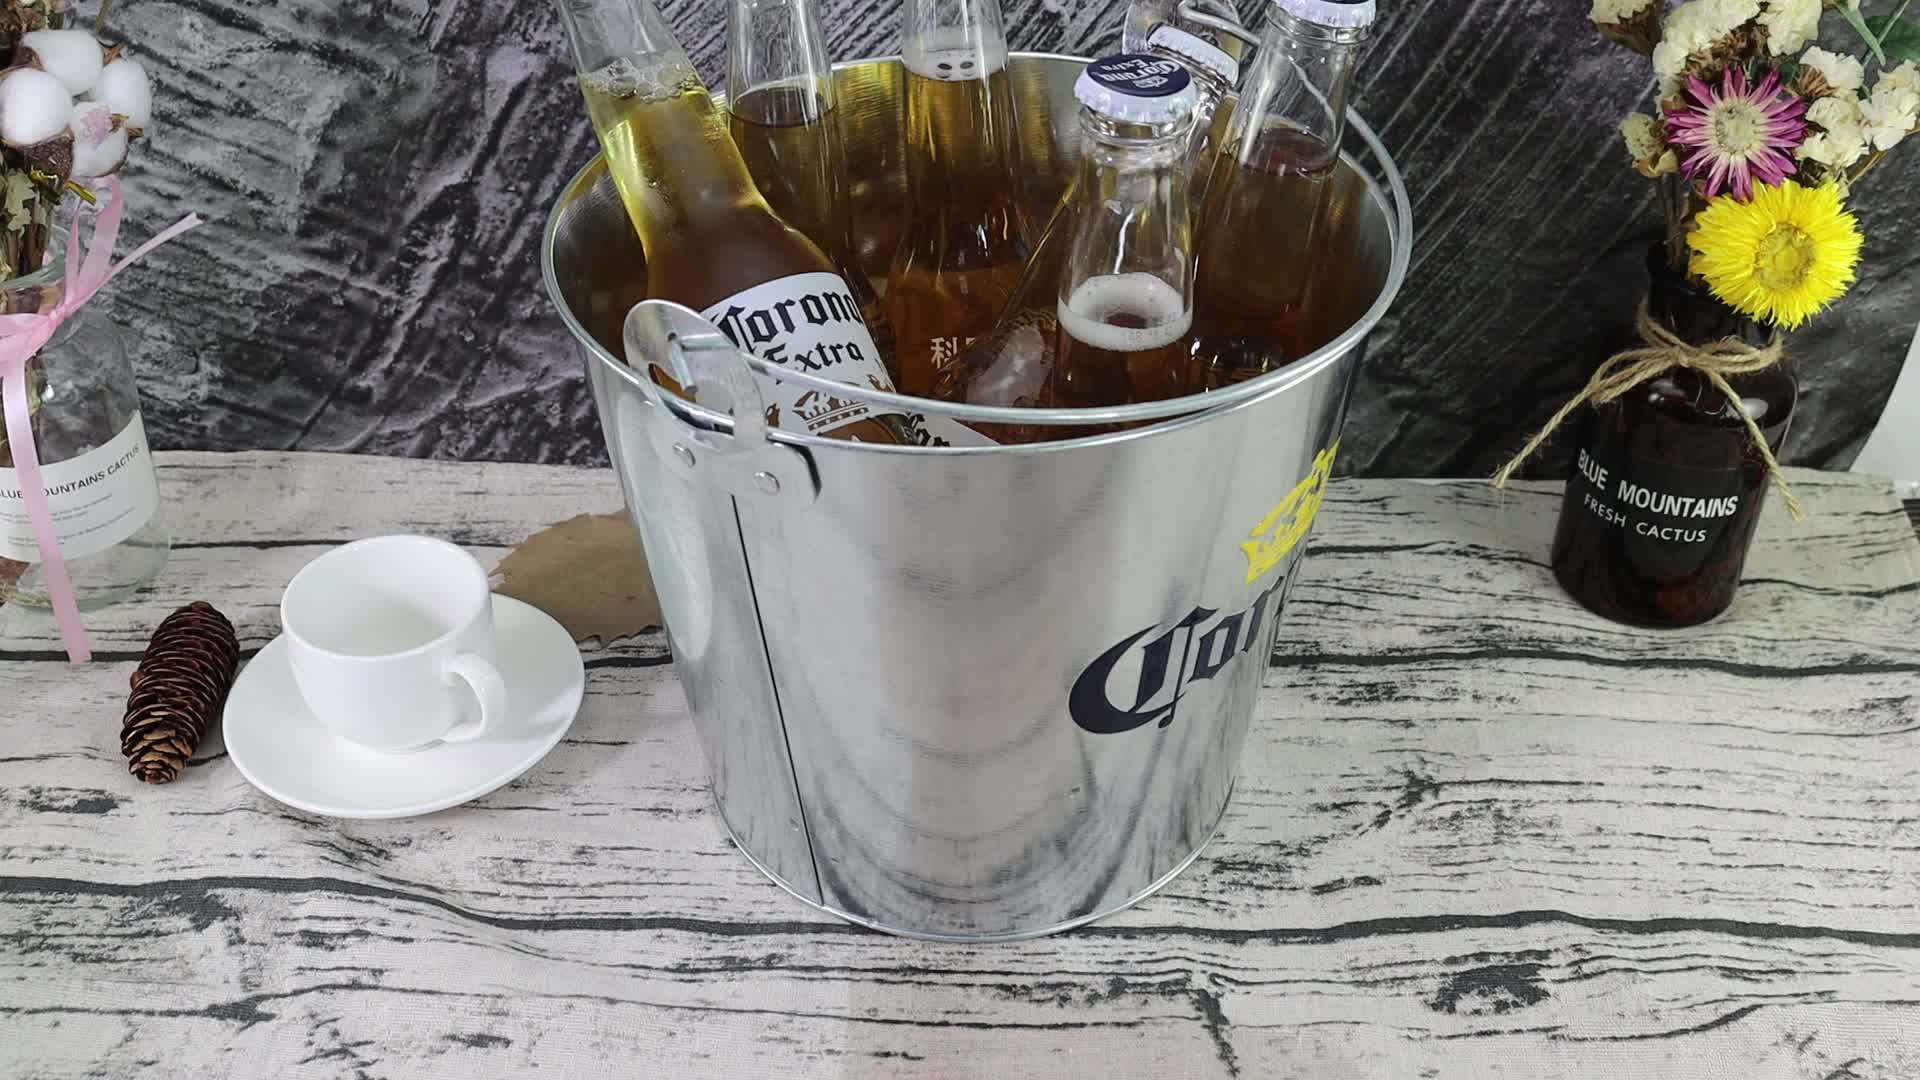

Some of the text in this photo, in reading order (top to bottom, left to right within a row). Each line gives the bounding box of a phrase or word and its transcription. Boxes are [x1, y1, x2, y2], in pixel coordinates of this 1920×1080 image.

[1092, 60, 1181, 83] Corona
[1099, 58, 1149, 73] Extra
[0, 489, 24, 499] LUE
[1578, 448, 1739, 519] BLUE MOUNTAINS
[1584, 493, 1708, 543] FRESH CACTUS
